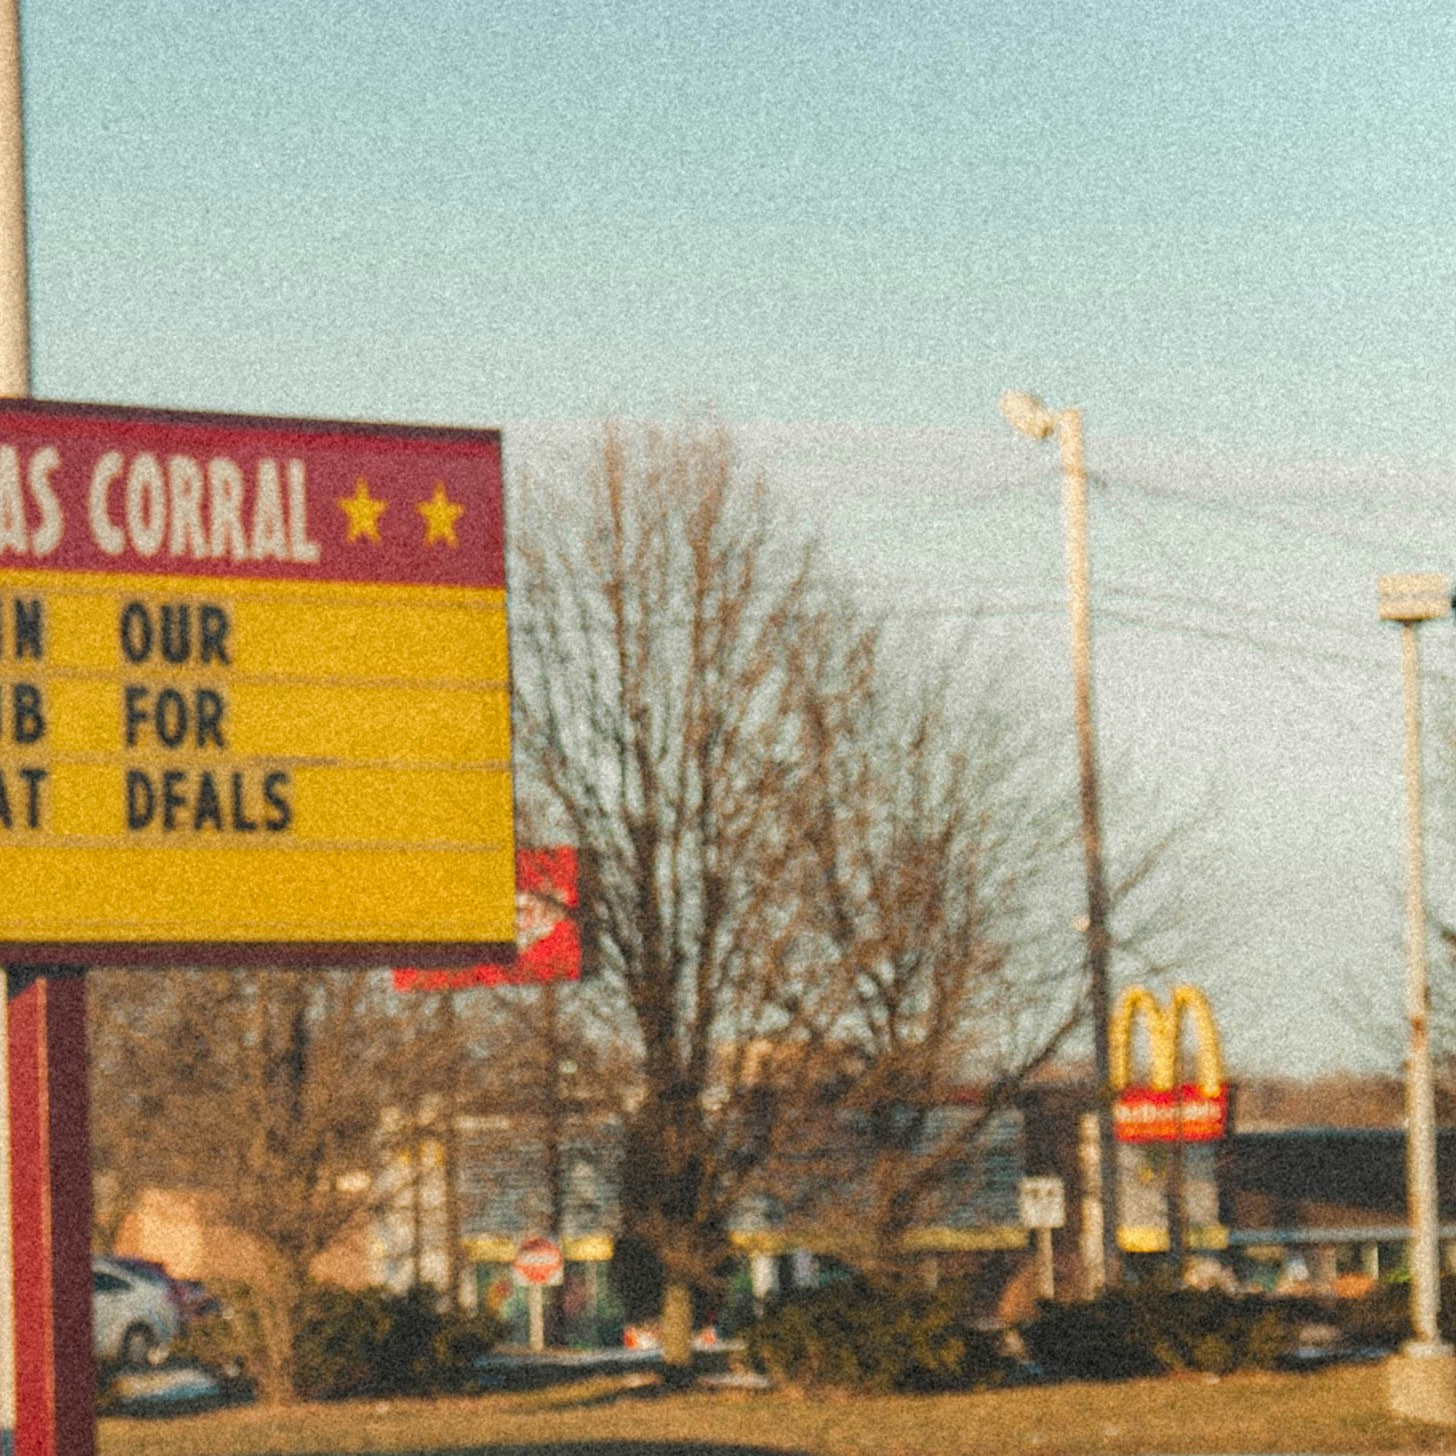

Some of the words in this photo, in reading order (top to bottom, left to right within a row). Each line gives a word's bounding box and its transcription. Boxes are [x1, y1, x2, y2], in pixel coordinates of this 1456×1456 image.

[87, 449, 321, 565] CORRAL
[120, 601, 230, 666] OUR
[124, 685, 226, 750] FOR
